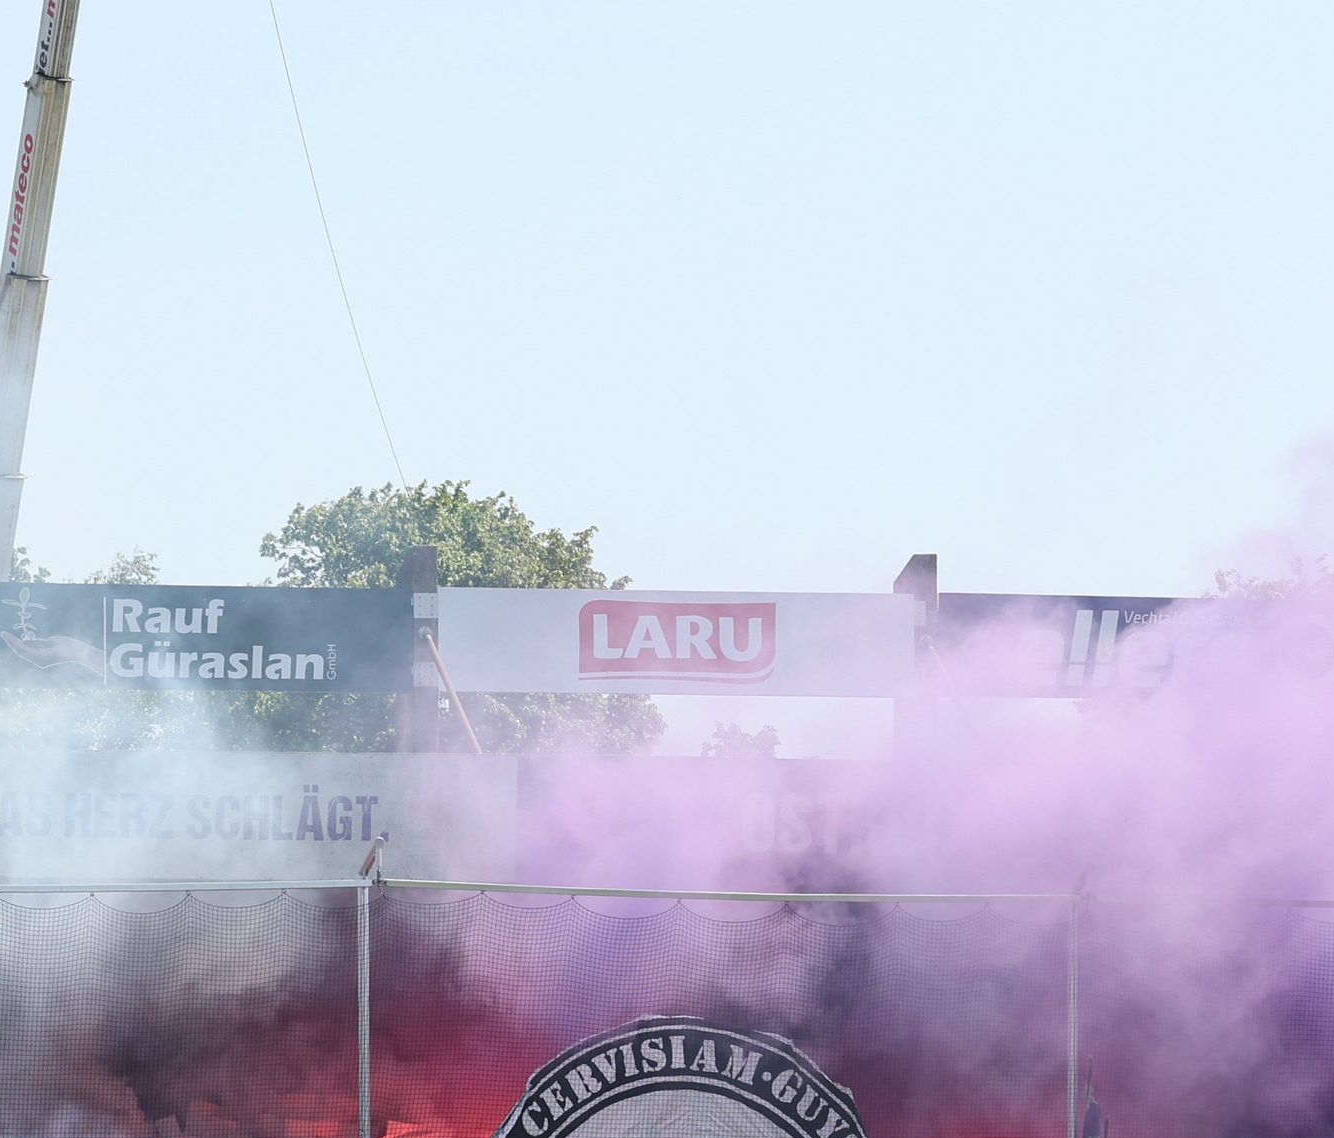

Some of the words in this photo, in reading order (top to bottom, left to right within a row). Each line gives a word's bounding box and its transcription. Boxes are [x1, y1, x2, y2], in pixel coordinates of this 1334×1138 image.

[8, 133, 34, 257] mateco
[112, 598, 226, 634] Rauf
[593, 613, 764, 663] LARU
[109, 640, 326, 681] Güraslan
[326, 643, 337, 681] GmbH
[65, 790, 175, 841] HERZ
[185, 783, 390, 843] SCHLÄGT.
[520, 1034, 764, 1138] CERVISIAM
